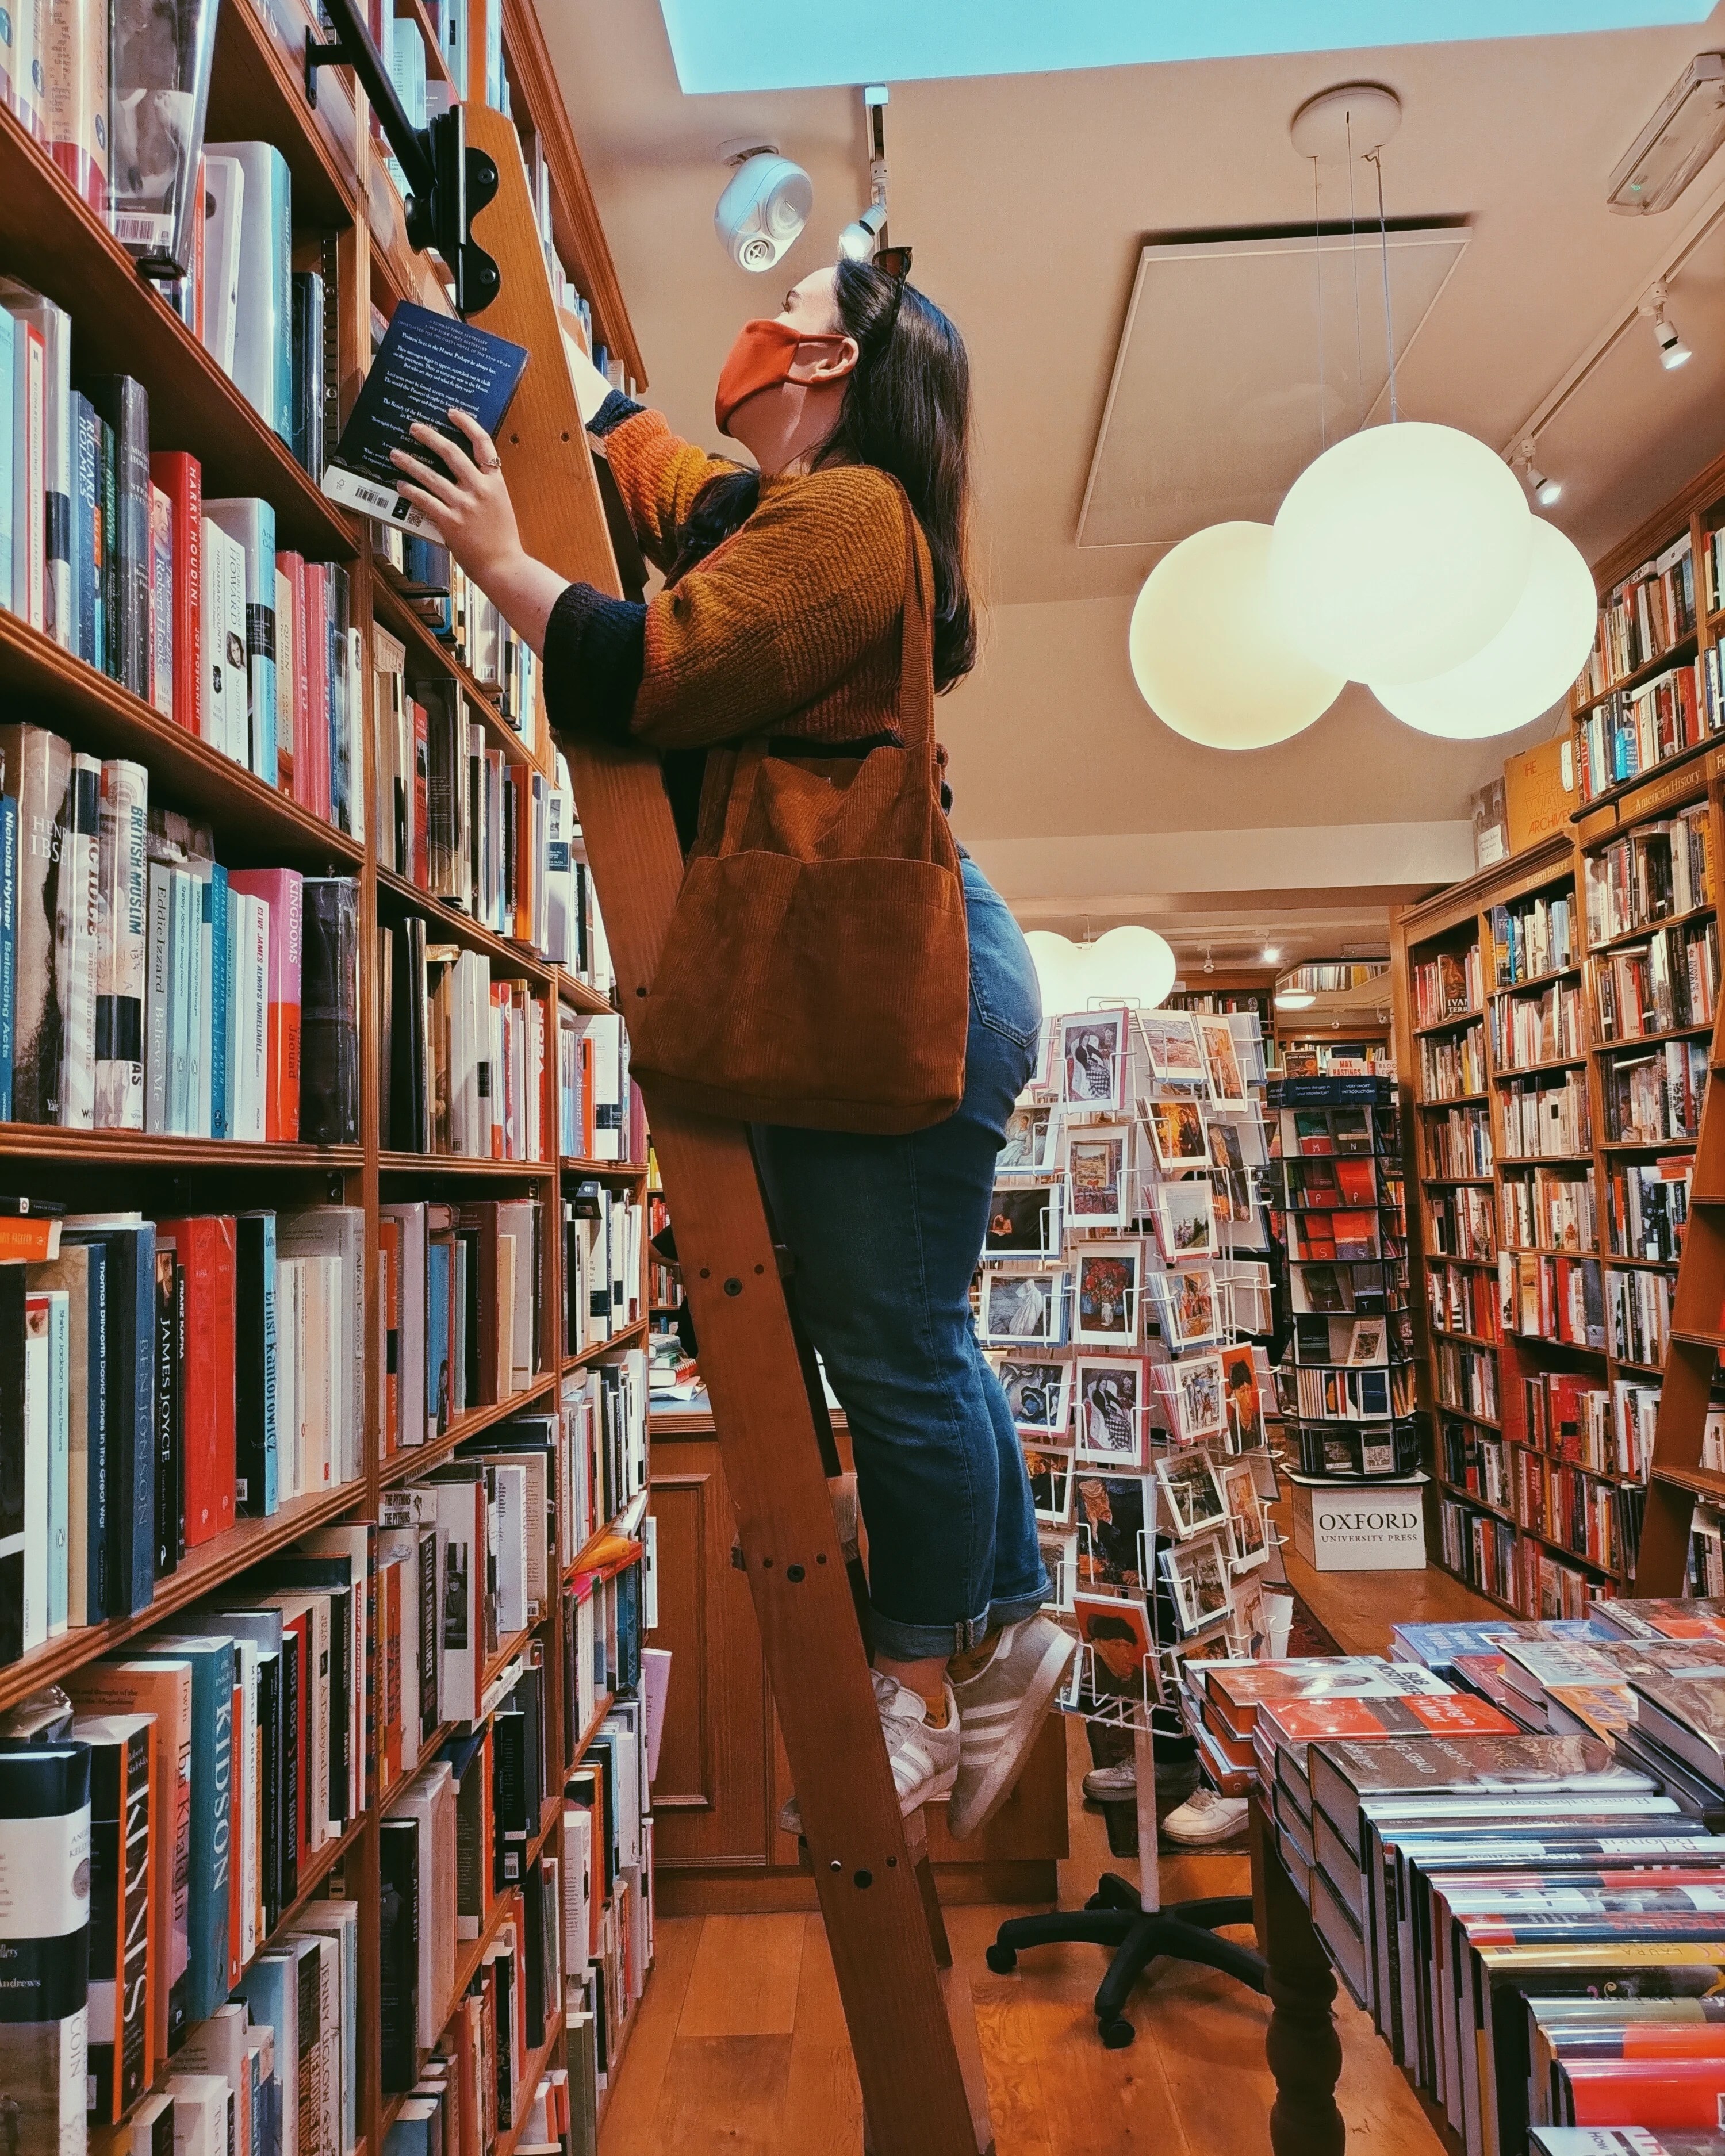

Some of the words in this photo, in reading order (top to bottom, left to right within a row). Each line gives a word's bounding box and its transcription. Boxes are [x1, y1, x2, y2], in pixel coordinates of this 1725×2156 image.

[405, 350, 423, 360] messages
[423, 355, 434, 365] begin
[451, 367, 470, 378] scratched
[480, 378, 491, 386] chalk
[417, 338, 428, 346] lives
[438, 346, 455, 357] House.
[453, 352, 471, 365] Perhaps
[474, 362, 489, 373] always
[424, 363, 436, 371] There
[439, 371, 456, 379] someone
[424, 371, 434, 379] they
[454, 383, 463, 391] they
[424, 393, 440, 403] thought
[389, 401, 405, 412] Beauty
[416, 411, 431, 420] House
[79, 415, 87, 497] HOLMES
[86, 419, 95, 508] RICHARD
[189, 466, 197, 524] HARRY
[156, 558, 166, 609] Robert
[190, 531, 198, 607] HOUDINI
[229, 546, 237, 626] HOWARD
[156, 618, 167, 673] Hooke
[1635, 785, 1670, 813] American
[1670, 768, 1701, 792] History
[5, 810, 13, 878] Nicholas
[130, 805, 143, 870] BRITISH
[1526, 869, 1547, 888] Eastern
[1547, 860, 1569, 878] History
[3, 880, 13, 930] Hytner
[129, 872, 143, 936] MUSLIM
[156, 886, 167, 935] Eddie
[289, 878, 298, 964] KINGDOMS
[3, 940, 12, 1018] Balancing
[155, 937, 166, 993] Izzard
[154, 1006, 164, 1071] Believe
[289, 1024, 297, 1079] Jaouad
[1339, 1060, 1353, 1068] MAX
[47, 1099, 59, 1112] Yale
[154, 1073, 163, 1102] Me
[1313, 1144, 1321, 1152] M
[1350, 1142, 1357, 1151] N
[1316, 1194, 1321, 1204] P
[1354, 1192, 1359, 1203] P
[355, 1253, 363, 1296] Alfred
[1319, 1247, 1328, 1258] S
[1358, 1248, 1366, 1258] S
[266, 1291, 277, 1337] Ernst
[1324, 1300, 1333, 1309] T
[1361, 1301, 1370, 1310] T
[139, 1339, 149, 1392] BEN
[160, 1317, 171, 1388] JAMES
[266, 1341, 277, 1454] Kantorowicz
[99, 1433, 105, 1445] in
[160, 1392, 170, 1463] JOYCE
[138, 1406, 148, 1526] JONSON
[1319, 1513, 1417, 1530] OXFORD
[1321, 1534, 1384, 1542] UNIVERSITY
[1378, 1663, 1425, 1696] MORTIMER
[289, 1698, 297, 1737] DOG
[1421, 1705, 1450, 1723] Mart
[1432, 1695, 1461, 1721] Crying
[178, 1740, 190, 1788] Ibn
[289, 1759, 297, 1799] PHIL
[213, 1701, 231, 1892] KIDSON
[1498, 1798, 1547, 1807] World
[1601, 1797, 1651, 1806] Home
[288, 1801, 296, 1860] KNIGHT
[174, 1798, 190, 1921] Khaldun
[1623, 1948, 1684, 1956] LAURA
[320, 1960, 329, 2020] JENNY
[70, 2016, 82, 2078] COIN
[320, 2029, 331, 2103] UGLOW
